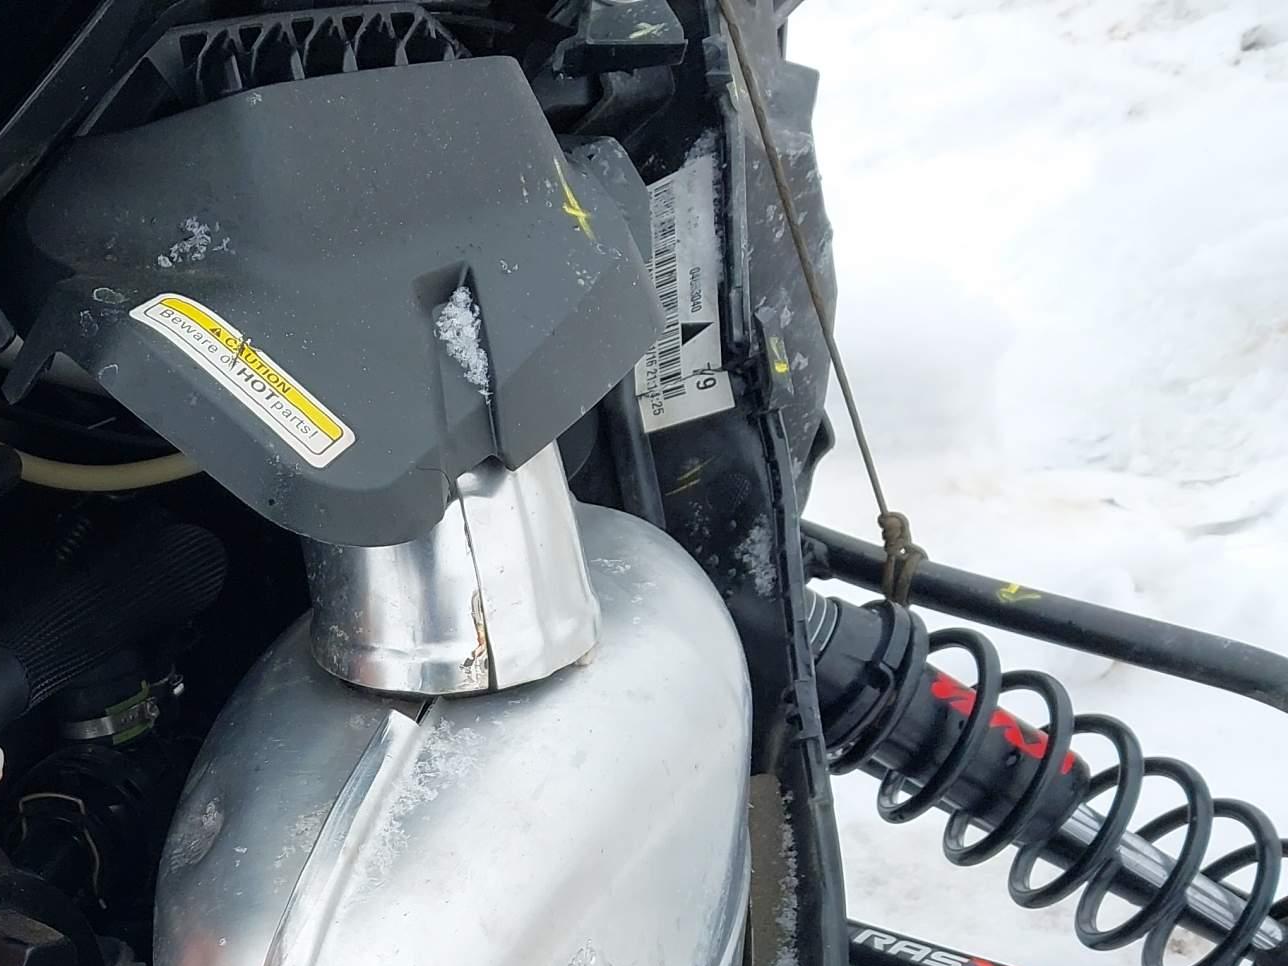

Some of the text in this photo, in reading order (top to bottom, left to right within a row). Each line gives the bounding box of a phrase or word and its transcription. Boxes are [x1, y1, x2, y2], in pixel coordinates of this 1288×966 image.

[159, 308, 218, 354] Beware
[220, 352, 240, 369] of
[225, 337, 291, 394] CAUTION
